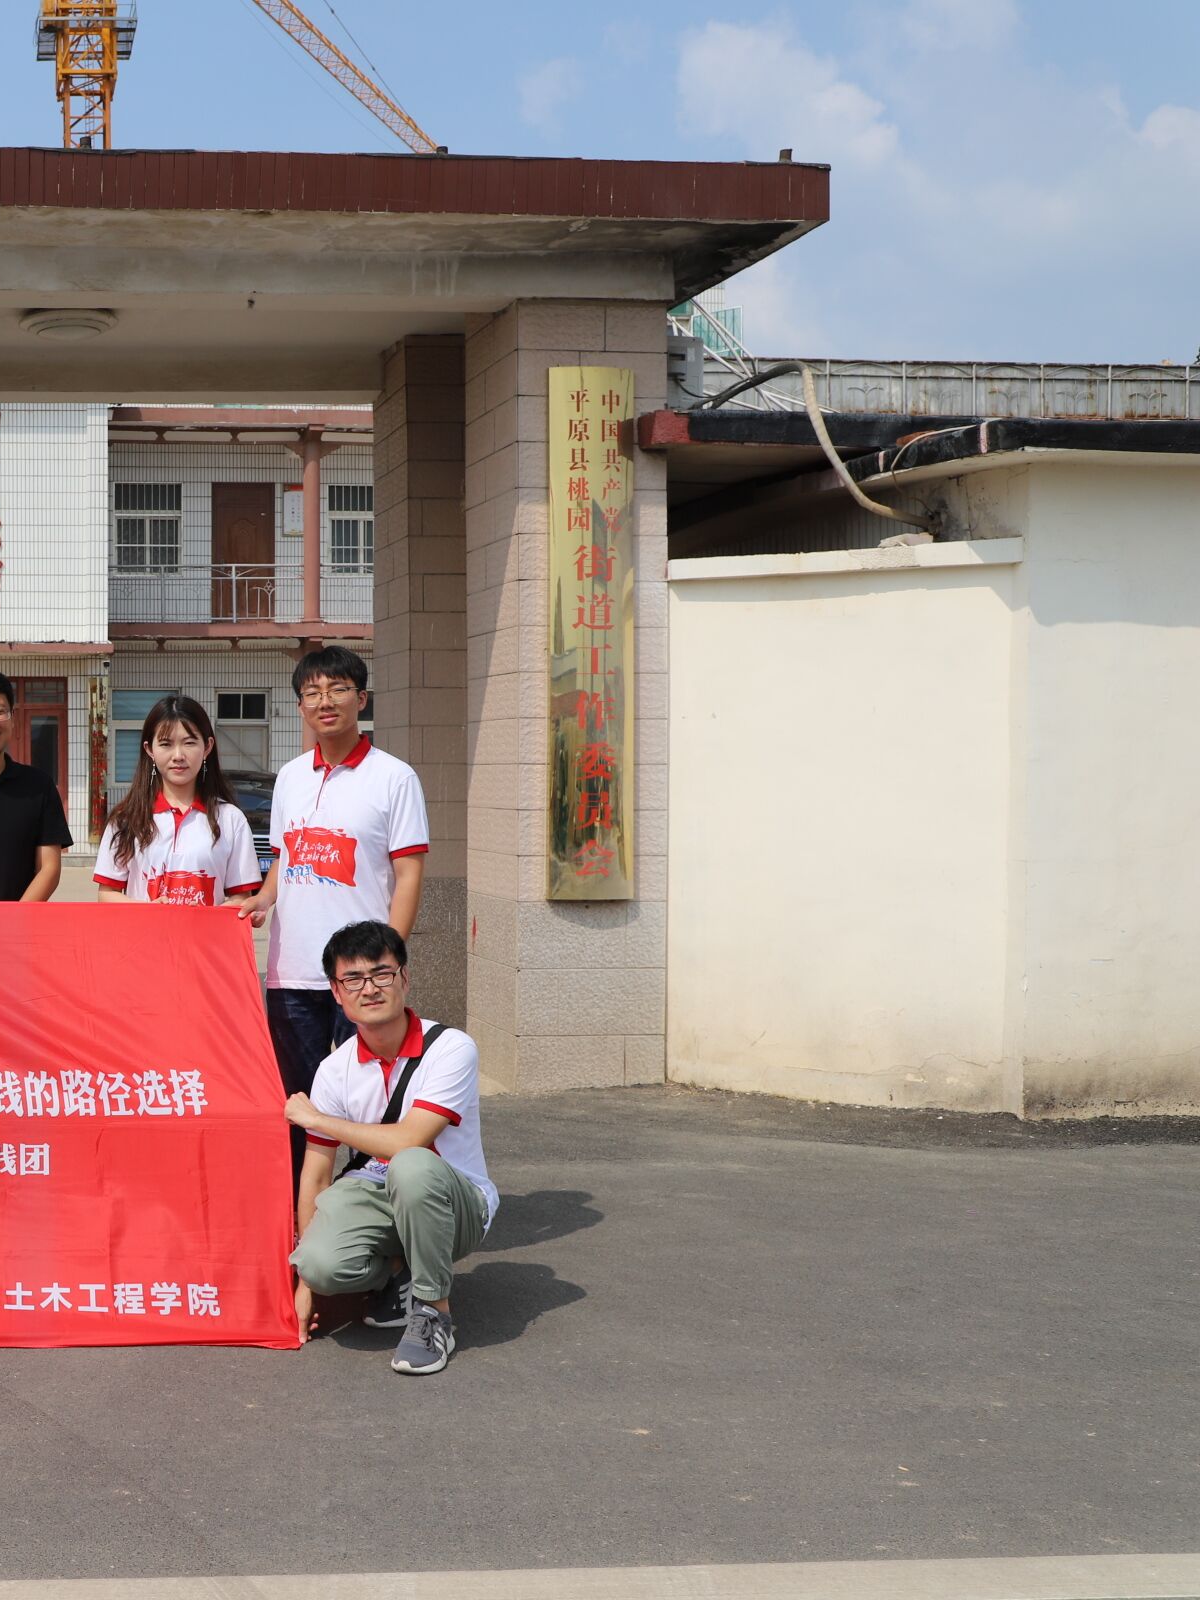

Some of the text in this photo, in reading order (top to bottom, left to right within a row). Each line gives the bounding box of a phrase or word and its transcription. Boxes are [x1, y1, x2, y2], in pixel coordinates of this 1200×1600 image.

[567, 389, 590, 532] 平原县桃园
[601, 390, 623, 533] 中国共产党
[573, 545, 617, 877] 街道工作委员会
[3, 1281, 221, 1317] 土木工程学院
